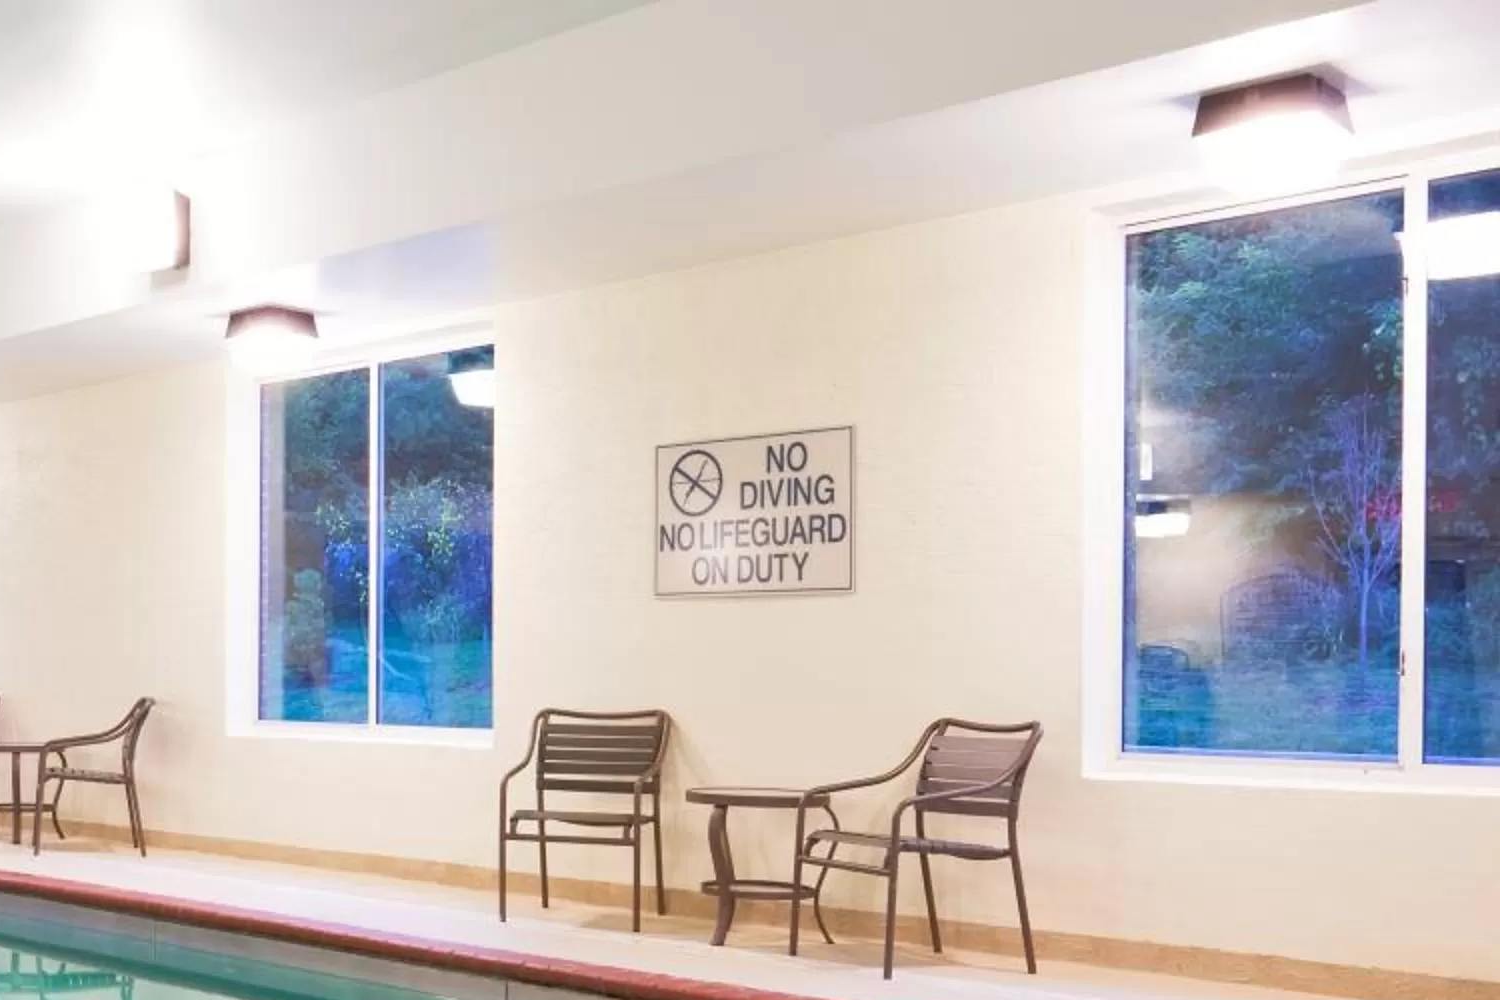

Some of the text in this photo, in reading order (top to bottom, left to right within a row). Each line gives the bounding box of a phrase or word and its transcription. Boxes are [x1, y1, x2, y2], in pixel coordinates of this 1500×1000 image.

[766, 442, 808, 474] NO
[740, 474, 835, 510] DIVING
[659, 513, 847, 552] NO LIFEGUARD
[691, 552, 809, 585] ON DUTY
